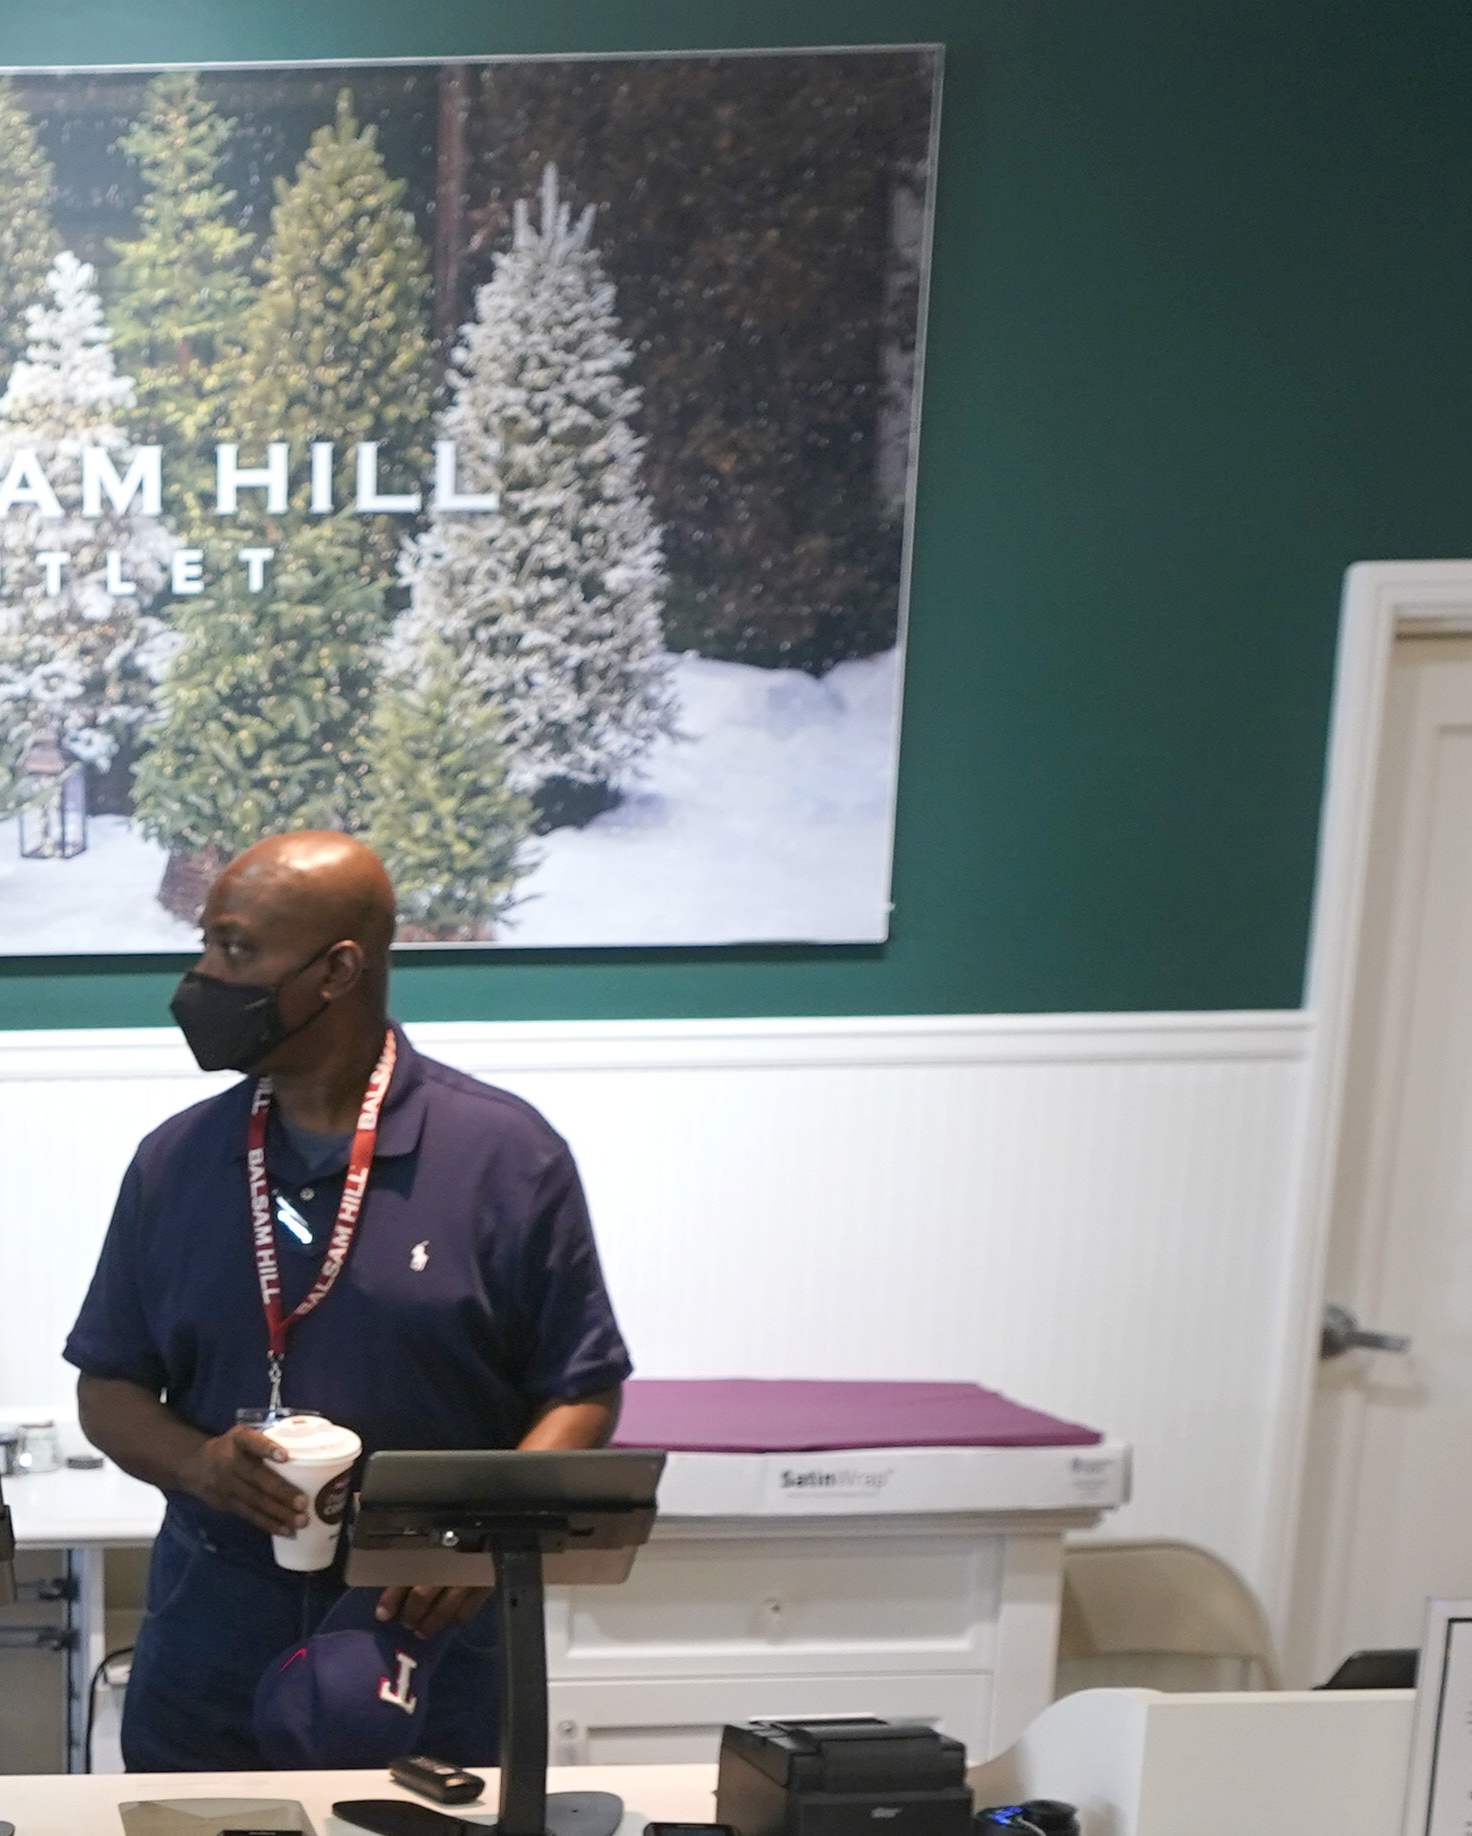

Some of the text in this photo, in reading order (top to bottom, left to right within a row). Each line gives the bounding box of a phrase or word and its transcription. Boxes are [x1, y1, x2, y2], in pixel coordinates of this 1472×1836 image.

[215, 440, 498, 514] HILL
[251, 1077, 273, 1115] ILL
[247, 1148, 280, 1305] BALSAM HILL
[293, 1167, 368, 1315] BALSAM HILL
[377, 1649, 418, 1715] T
